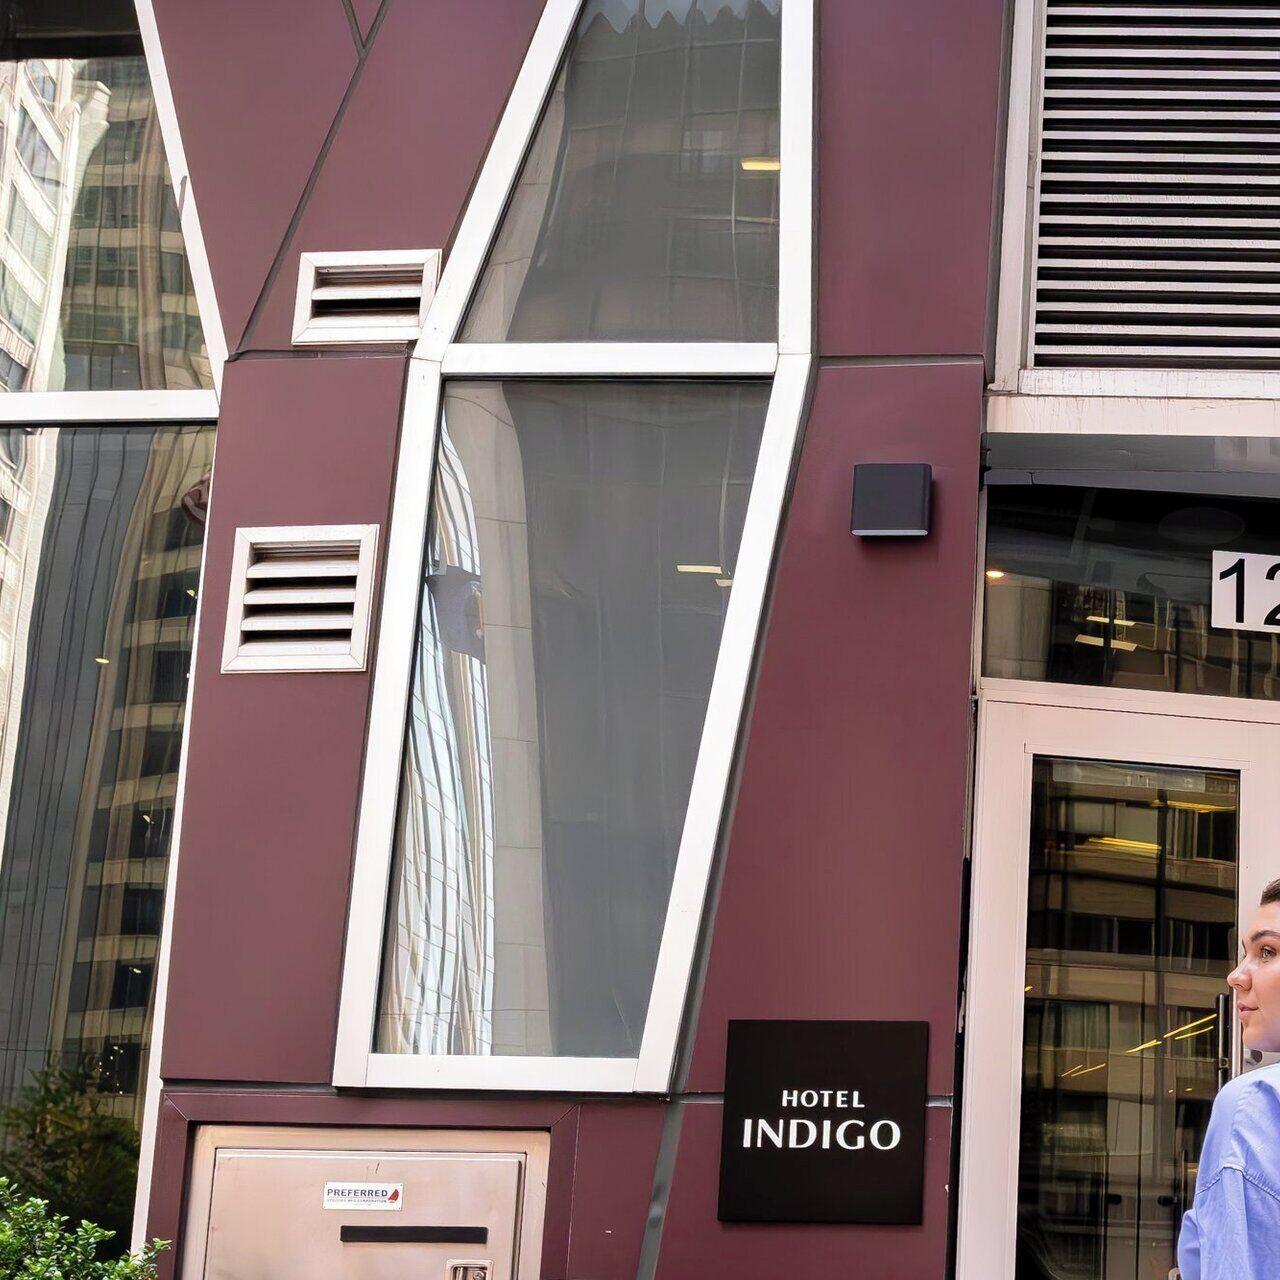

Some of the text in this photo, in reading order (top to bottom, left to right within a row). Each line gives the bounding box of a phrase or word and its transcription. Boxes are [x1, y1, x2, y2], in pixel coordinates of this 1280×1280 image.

[781, 1089, 865, 1108] HOTEL
[742, 1118, 902, 1151] INDIGO
[326, 1188, 389, 1197] PREFERRED
